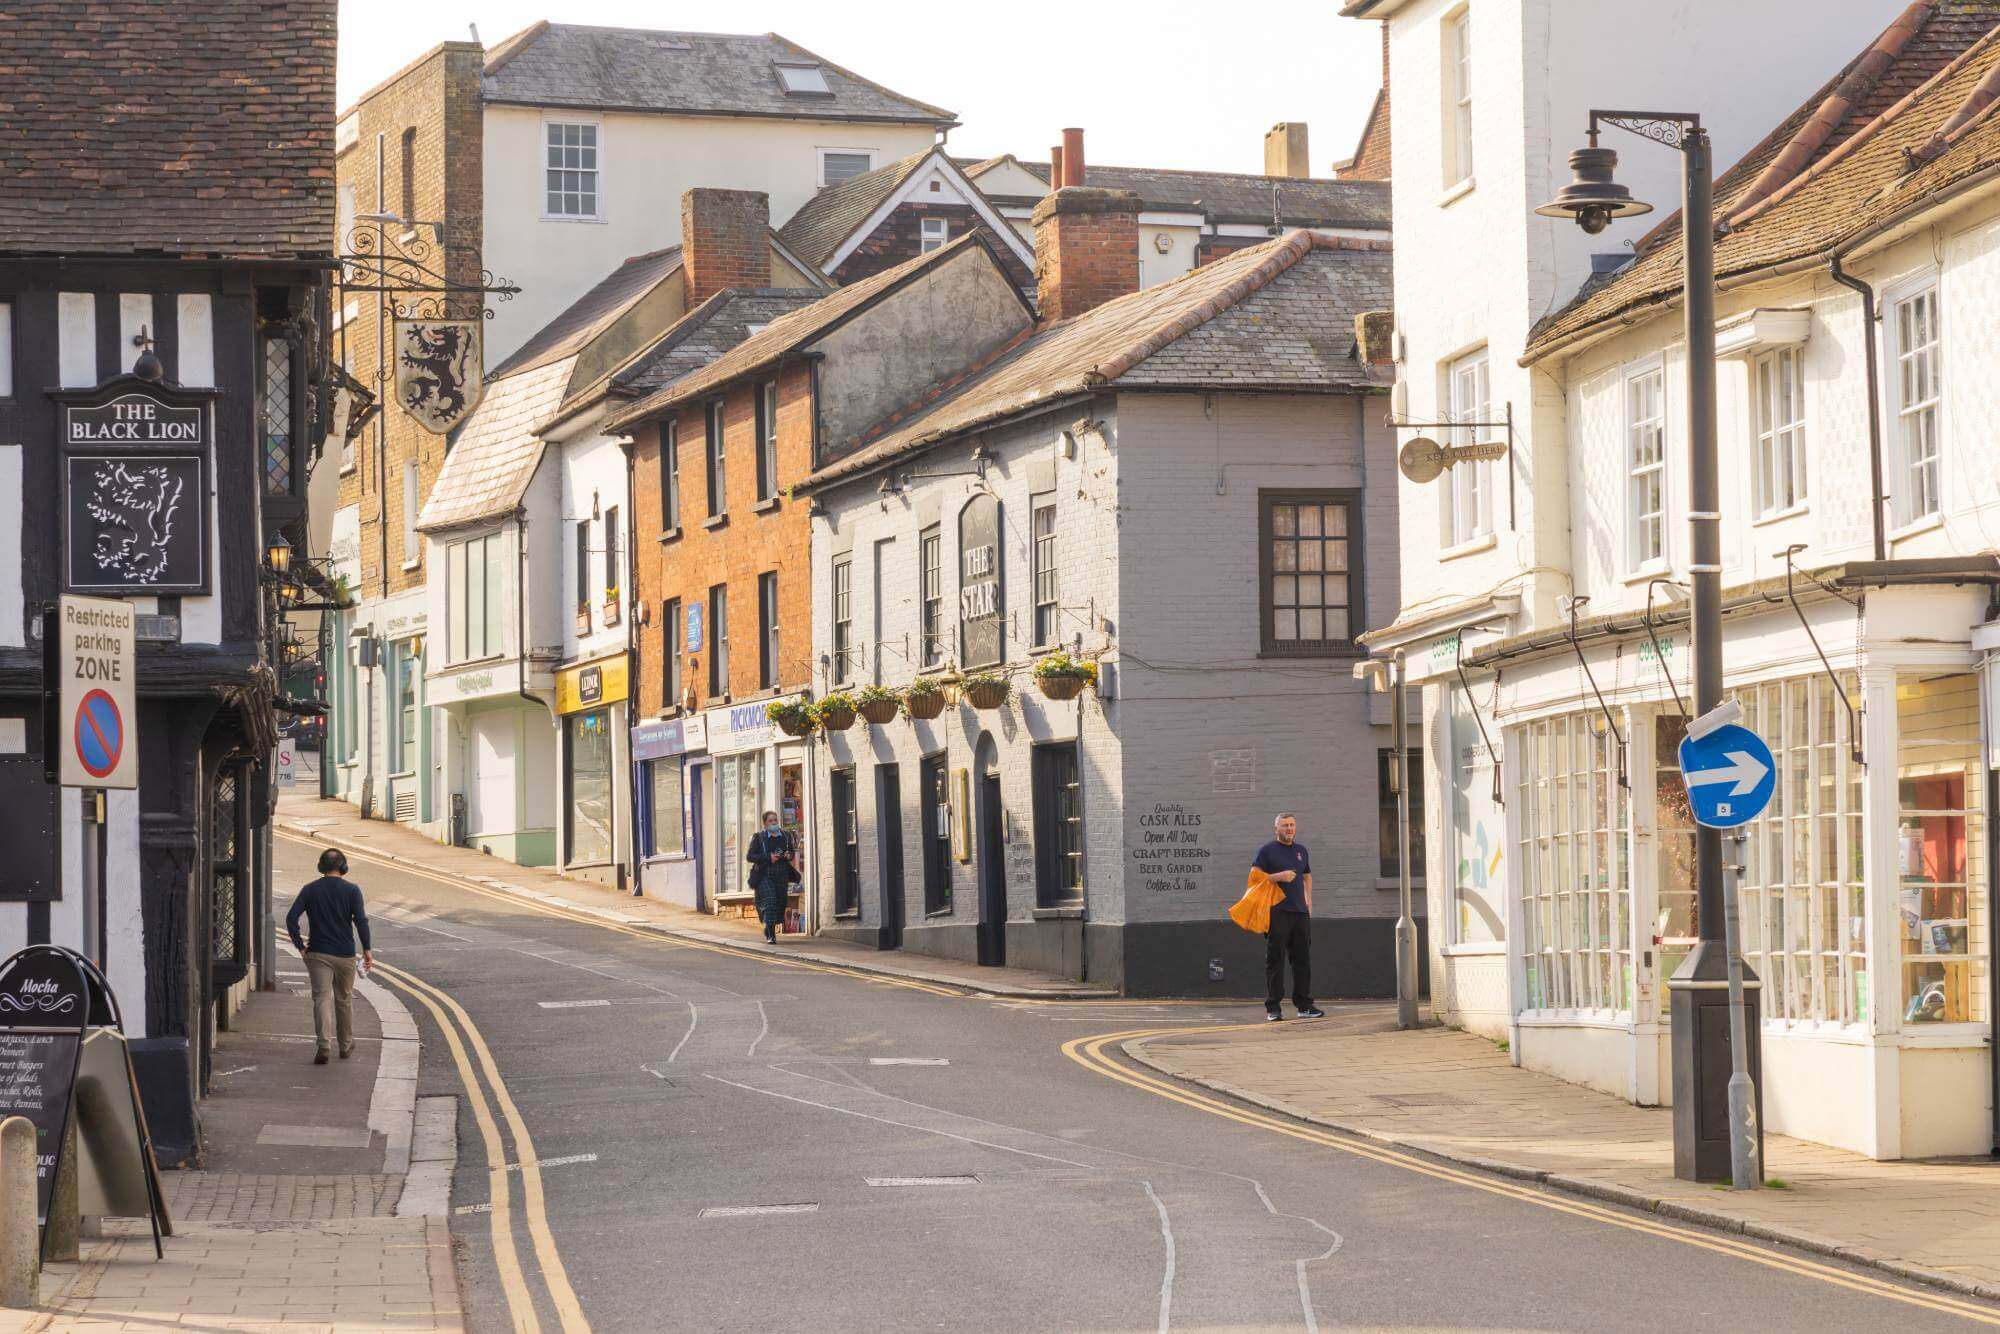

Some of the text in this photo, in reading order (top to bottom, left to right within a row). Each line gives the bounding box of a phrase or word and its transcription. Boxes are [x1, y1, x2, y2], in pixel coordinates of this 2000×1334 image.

[112, 404, 156, 420] THE
[72, 422, 196, 439] BLACK LION
[1477, 446, 1503, 456] HERE
[966, 546, 993, 576] THE
[961, 581, 997, 621] STAR
[66, 605, 129, 629] Restricted
[75, 632, 121, 655] parking
[1639, 637, 1674, 661] COOERS
[75, 656, 121, 682] ZONE
[731, 704, 771, 732] RICKMOR
[1154, 803, 1184, 814] Quality
[1140, 814, 1201, 826] CASK ALES
[1144, 830, 1198, 846] Open All Day
[1133, 848, 1210, 859] CRAFT BEERS
[1140, 863, 1202, 874] BEER GARDEN
[1146, 877, 1197, 891] Coffee & Tea
[20, 978, 59, 993] Mocha
